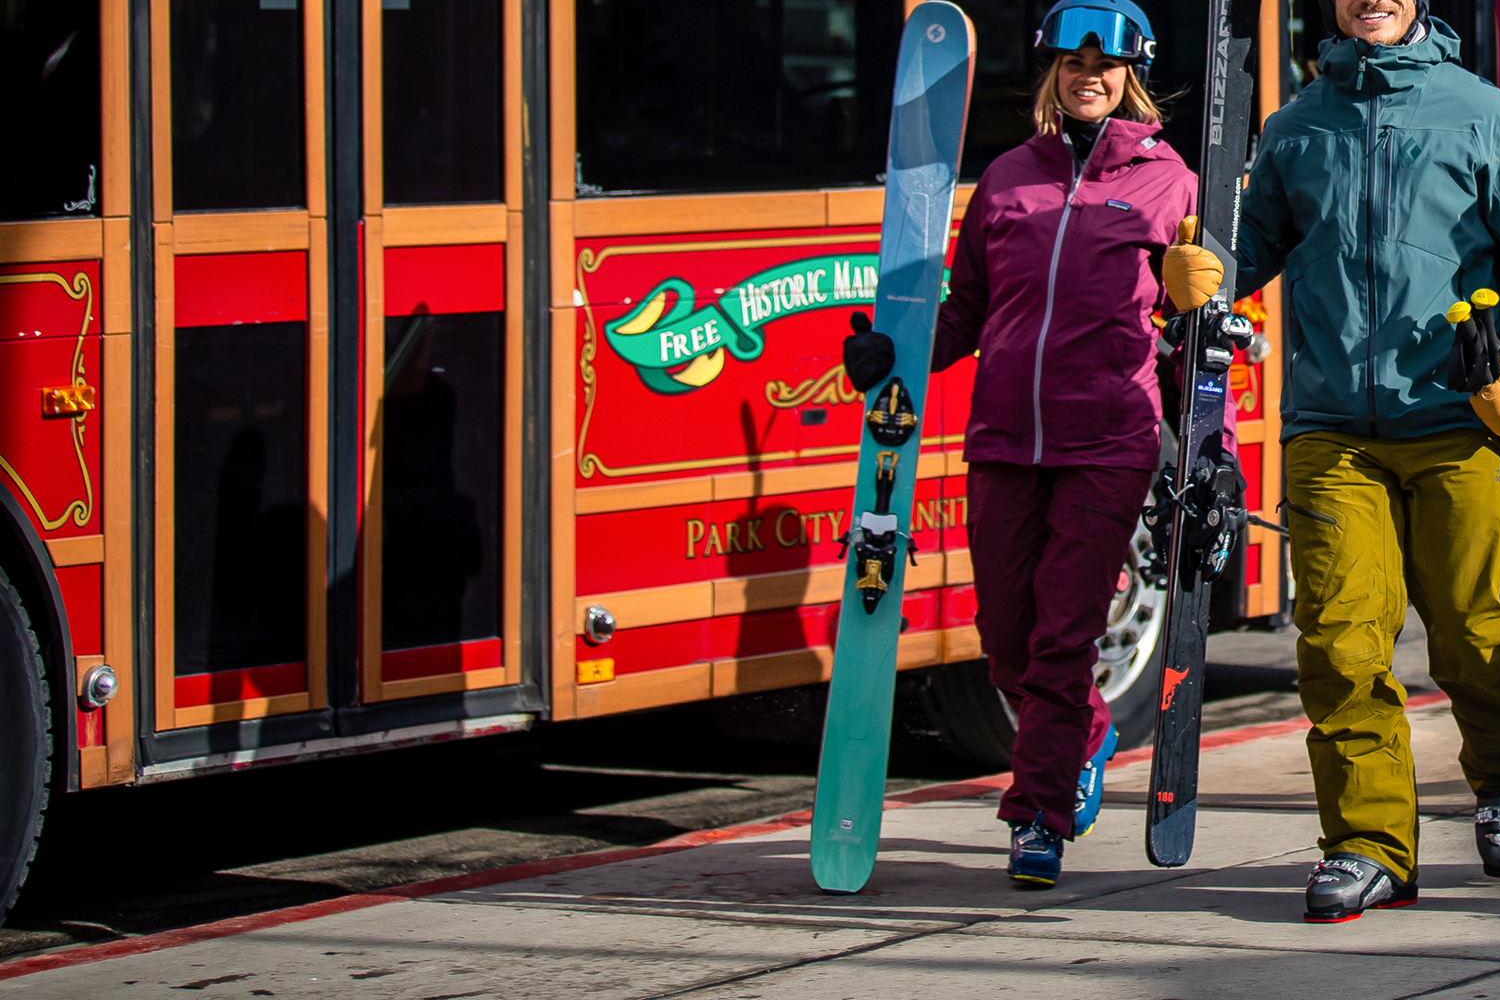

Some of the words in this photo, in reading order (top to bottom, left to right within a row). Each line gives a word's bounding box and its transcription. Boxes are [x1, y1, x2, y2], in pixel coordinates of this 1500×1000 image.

[1230, 177, 1242, 251] entwistlephoto.com
[659, 318, 721, 363] FREE
[738, 268, 827, 327] HISTORIC
[685, 517, 766, 560] PARK
[774, 508, 846, 549] CITY
[1156, 790, 1174, 803] 180
